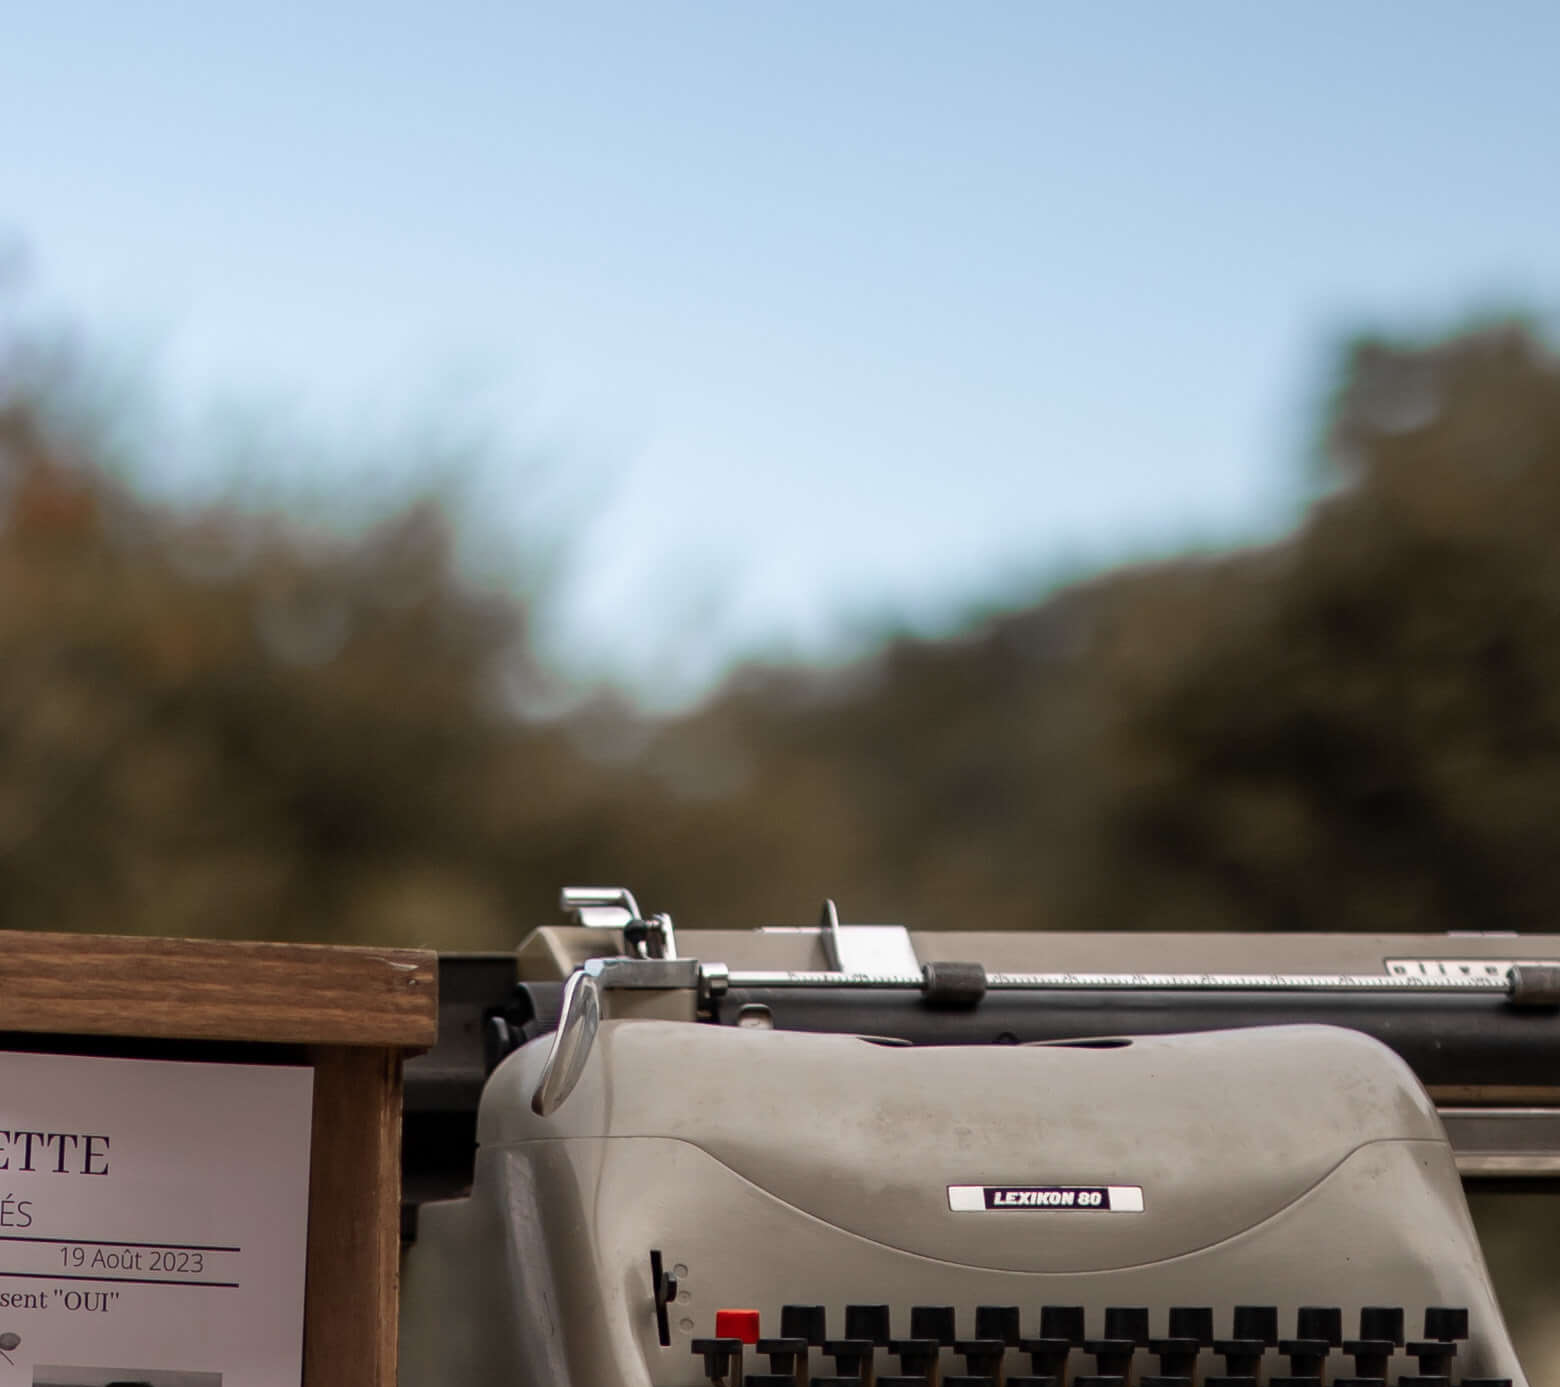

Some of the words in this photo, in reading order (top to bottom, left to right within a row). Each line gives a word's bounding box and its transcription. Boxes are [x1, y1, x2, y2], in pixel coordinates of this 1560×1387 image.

[1393, 962, 1498, 977] olive
[993, 1190, 1074, 1206] LEXIKON
[1078, 1191, 1102, 1206] 80
[60, 1246, 85, 1267] 19
[90, 1245, 144, 1271] Août
[149, 1246, 205, 1273] 2023
[53, 1288, 119, 1312] "OUI"
